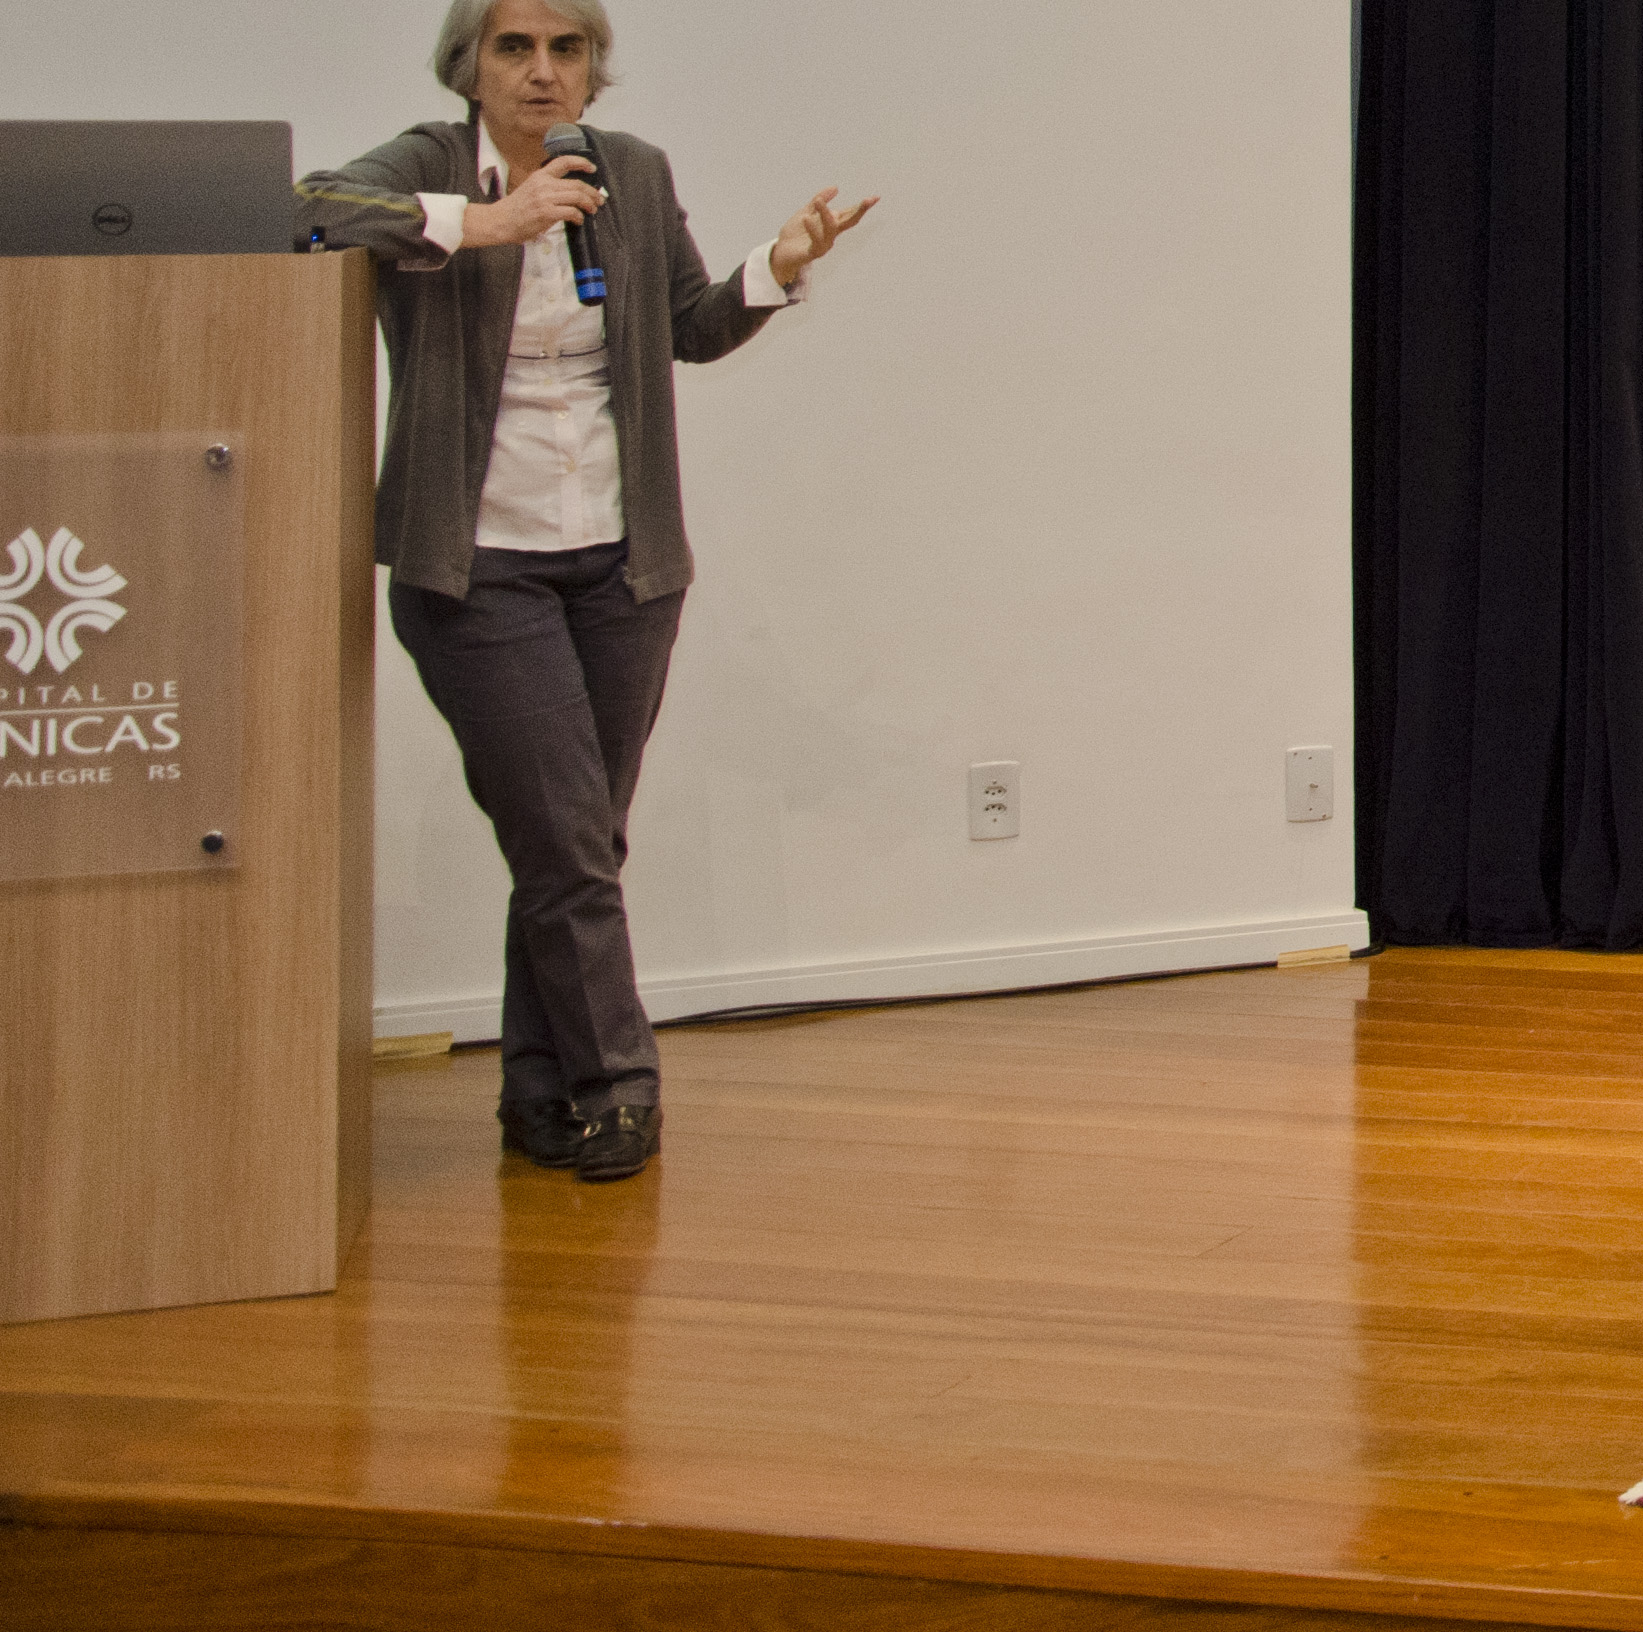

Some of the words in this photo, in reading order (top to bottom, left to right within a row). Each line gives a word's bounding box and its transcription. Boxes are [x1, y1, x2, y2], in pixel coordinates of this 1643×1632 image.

[133, 681, 176, 700] DE
[4, 767, 112, 787] ALEGRE
[149, 764, 181, 780] RS
